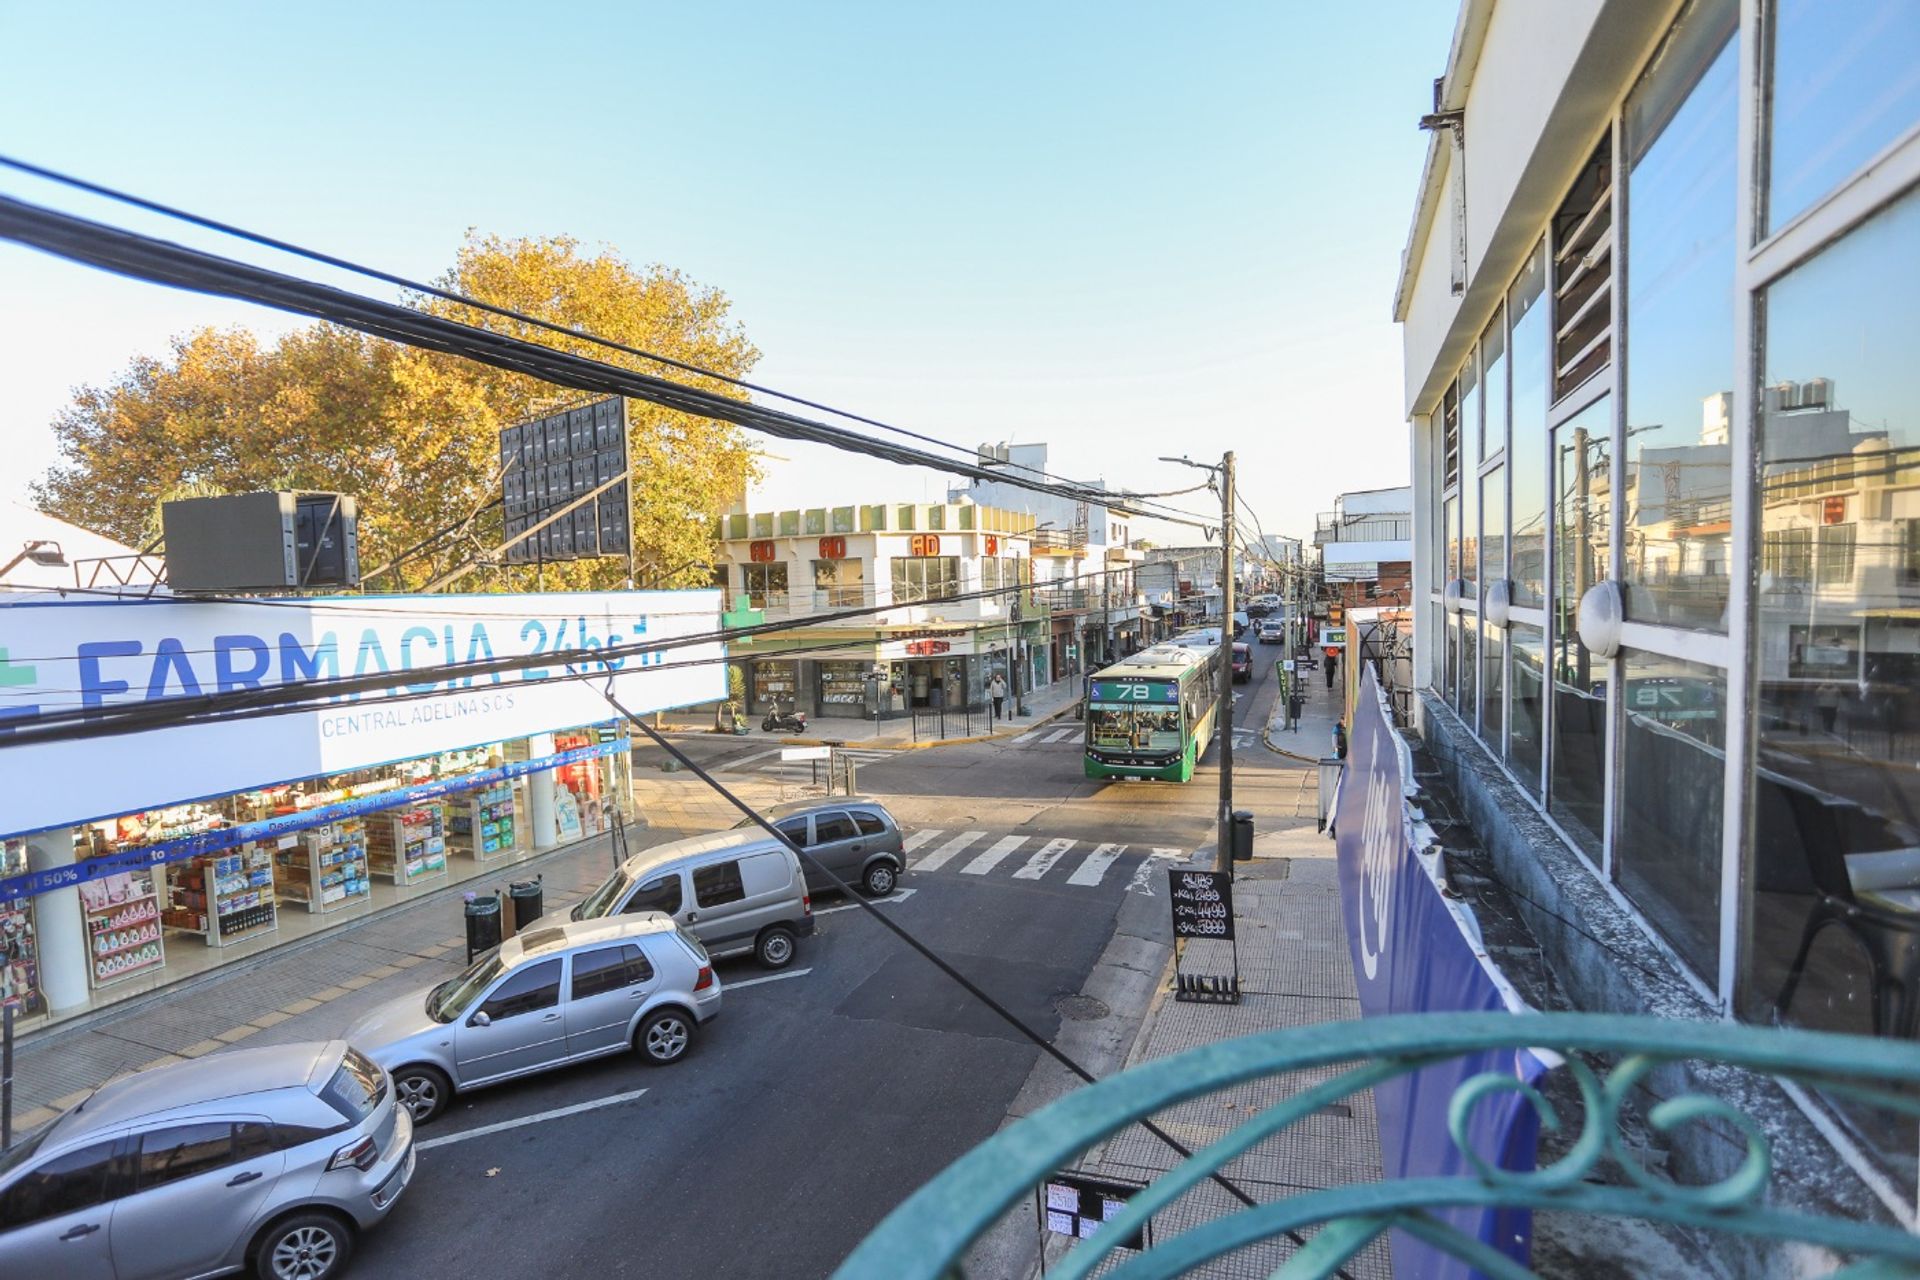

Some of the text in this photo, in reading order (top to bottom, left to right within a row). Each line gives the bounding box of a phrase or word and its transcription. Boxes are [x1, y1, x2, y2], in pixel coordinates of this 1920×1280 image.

[77, 621, 502, 722] FARMACIA
[1115, 684, 1149, 699] 78
[322, 710, 407, 738] CENTRAL
[411, 698, 478, 725] ADELINA
[43, 869, 78, 887] 50%
